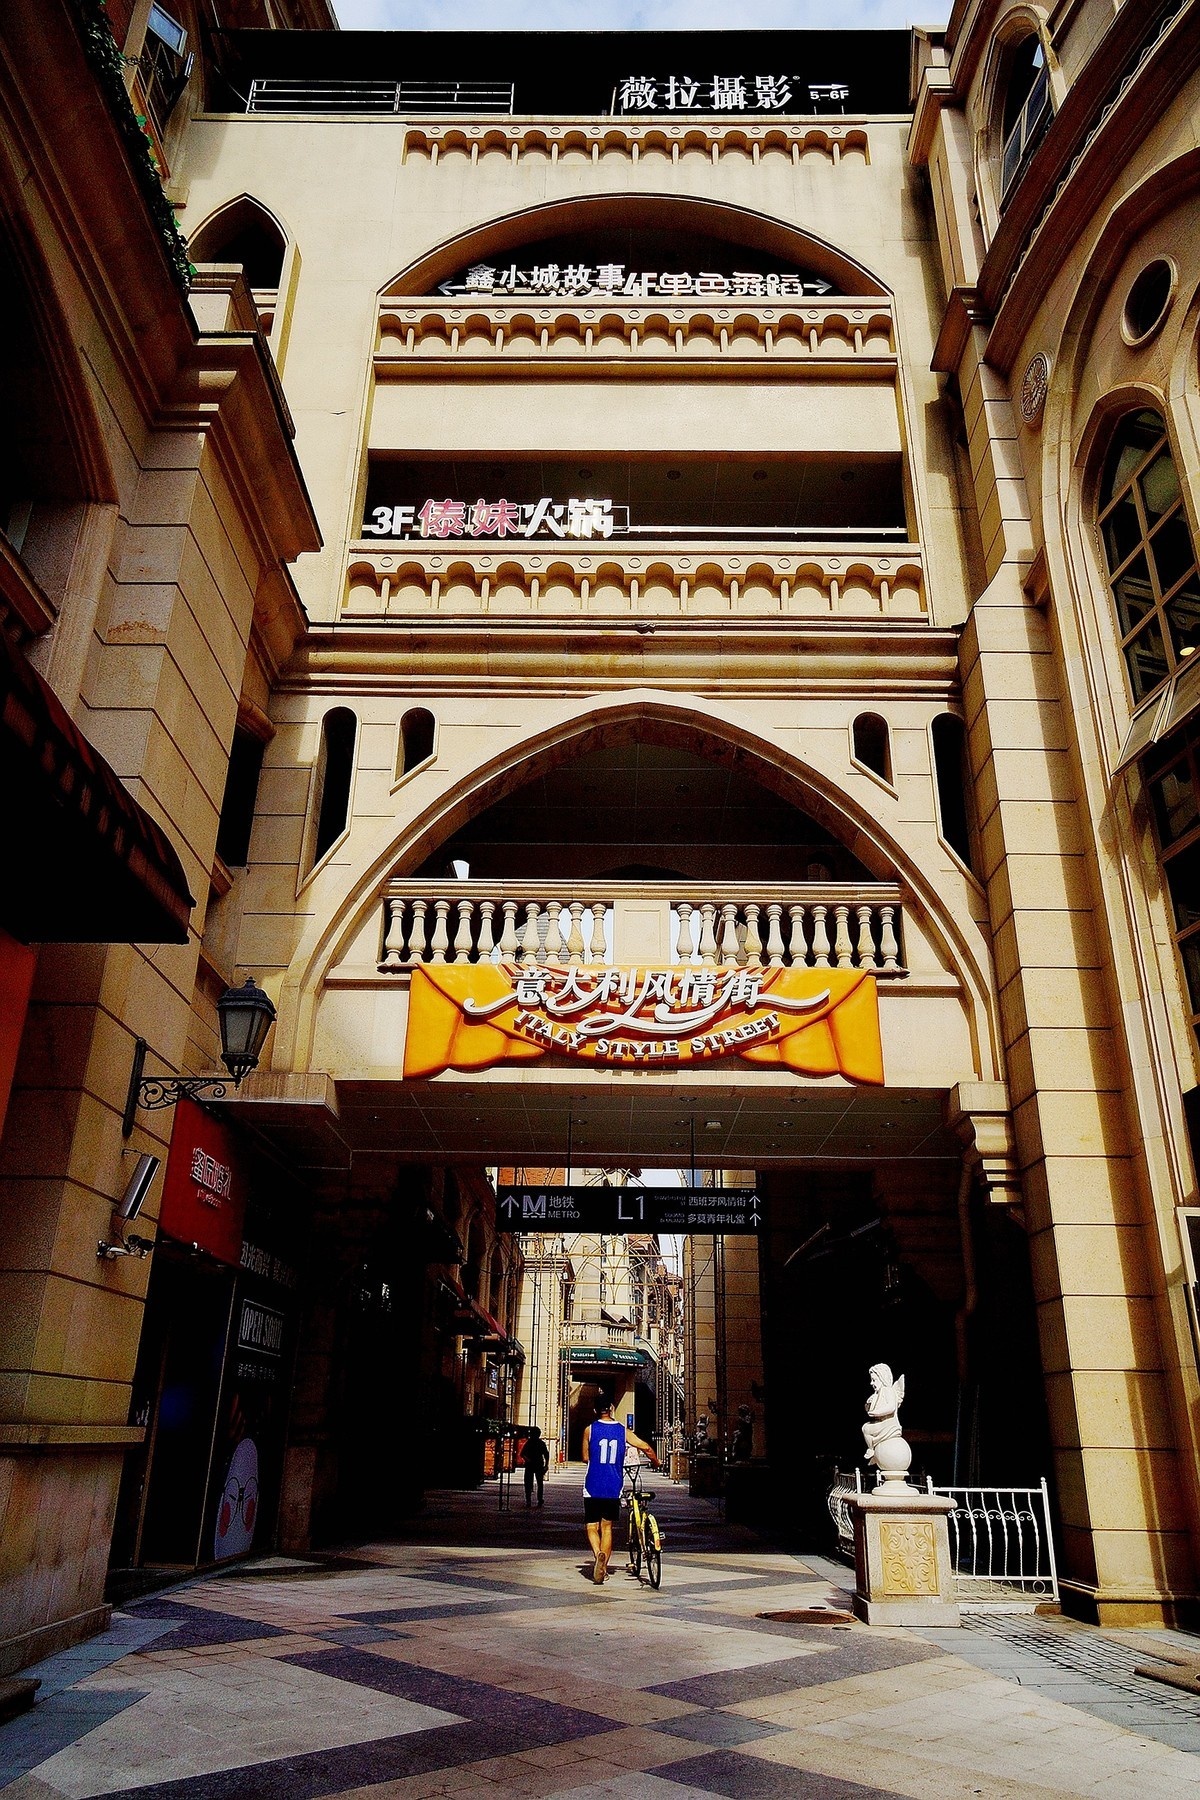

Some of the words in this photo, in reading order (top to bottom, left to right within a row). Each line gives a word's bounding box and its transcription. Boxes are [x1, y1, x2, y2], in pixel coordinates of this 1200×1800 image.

[511, 965, 764, 1010] 意大利风情街
[513, 1009, 588, 1050] ITALY
[595, 1037, 681, 1057] STYLE
[692, 1011, 781, 1053] STREET
[549, 1195, 575, 1209] 地铁
[617, 1195, 645, 1220] L1
[688, 1196, 747, 1207] 西班牙风情街
[548, 1211, 581, 1219] METRO
[242, 1307, 264, 1344] OPEN
[599, 1438, 618, 1464] 11
